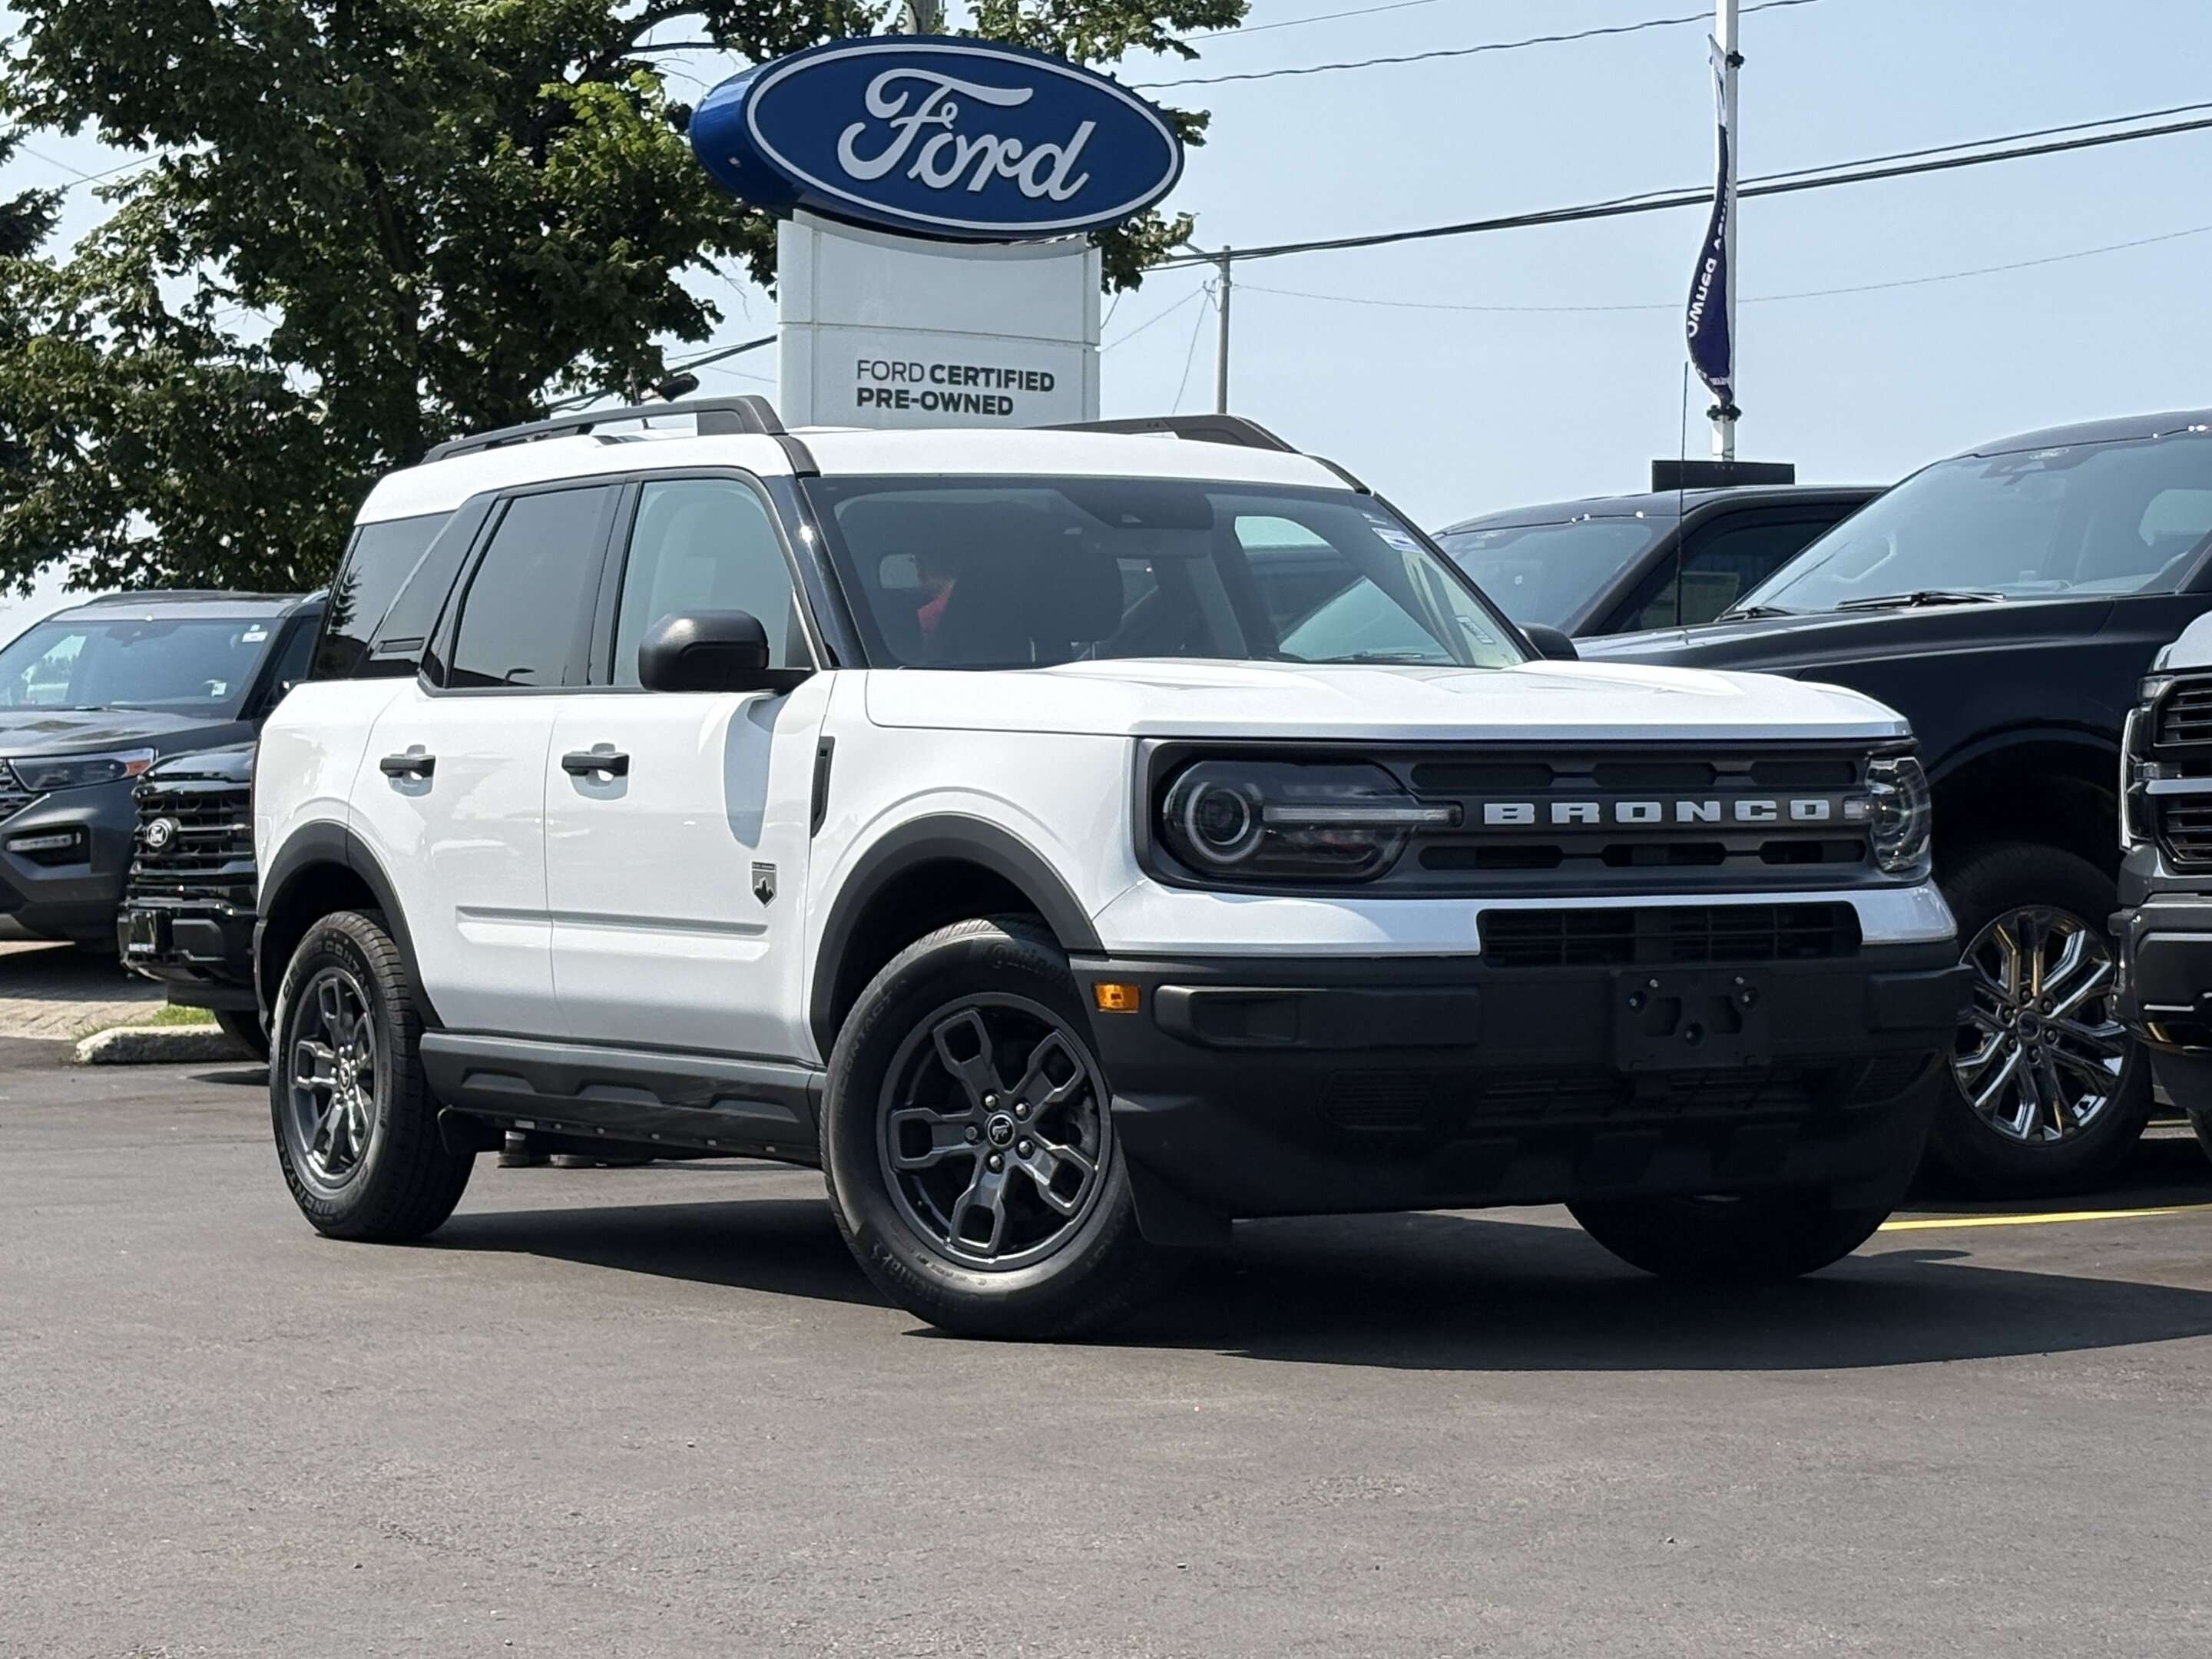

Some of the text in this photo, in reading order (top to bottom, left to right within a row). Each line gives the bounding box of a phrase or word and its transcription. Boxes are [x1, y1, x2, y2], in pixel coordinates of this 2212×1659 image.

[837, 68, 1096, 201] Ford
[856, 359, 1055, 392] FORD CERTIFIED
[856, 386, 1014, 416] PRE-OWNED
[1484, 799, 1830, 825] BRONCO
